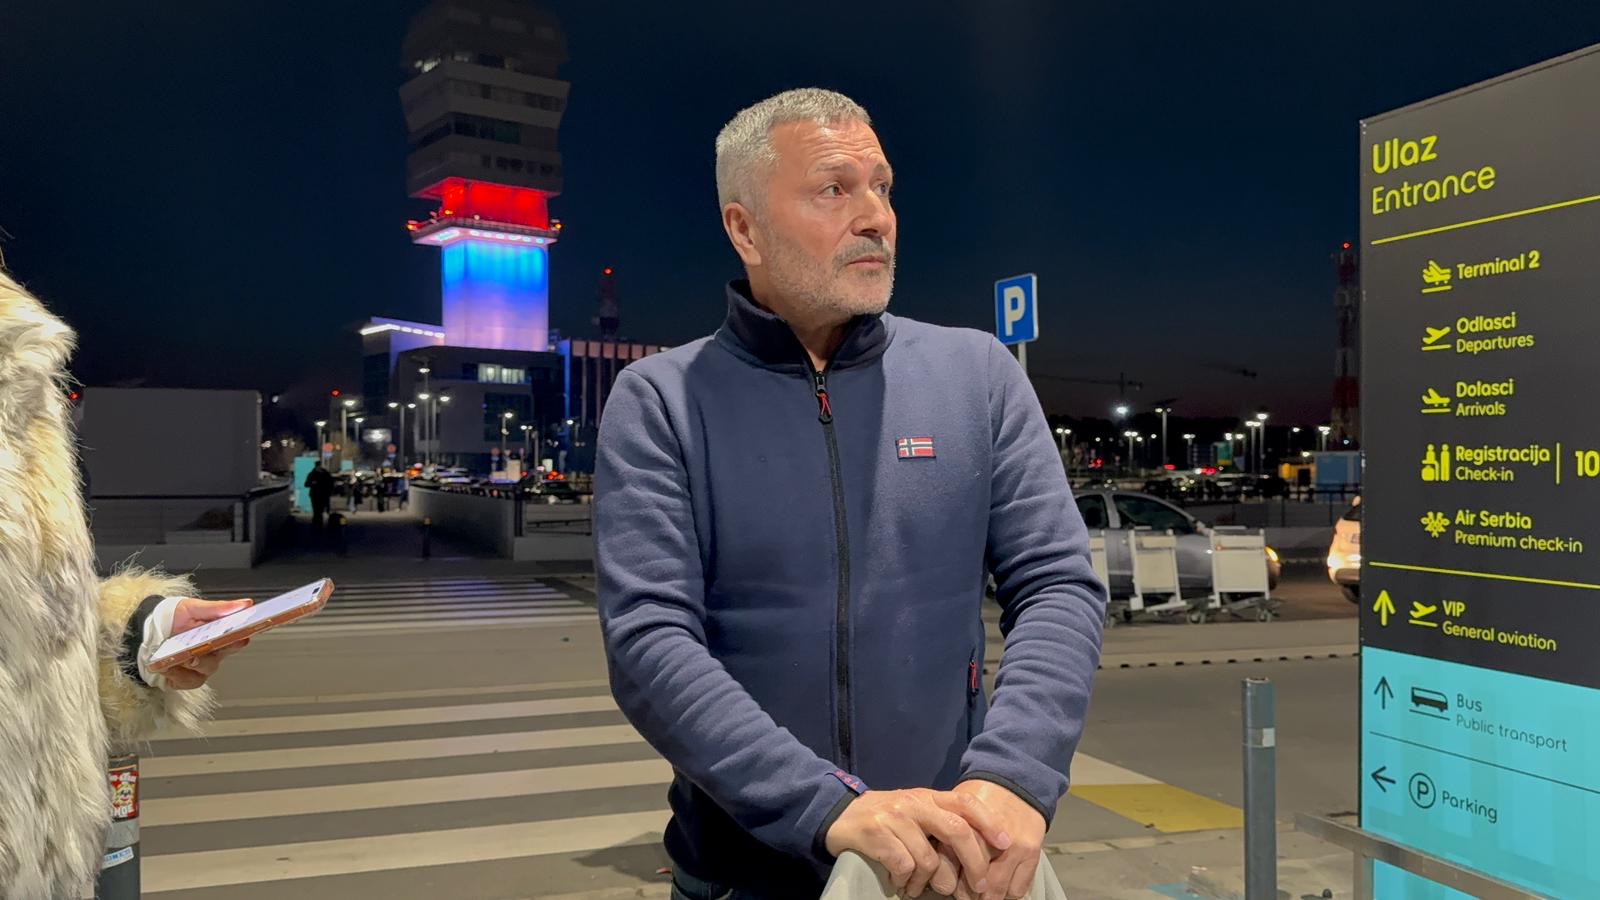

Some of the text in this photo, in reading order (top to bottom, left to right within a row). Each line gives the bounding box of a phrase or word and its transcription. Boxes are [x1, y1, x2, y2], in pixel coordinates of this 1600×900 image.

[1371, 134, 1438, 174] Ulaz
[1372, 165, 1496, 215] Entrance
[1456, 250, 1540, 279] Terminal 2
[1003, 285, 1026, 337] P
[1456, 312, 1516, 334] Odlasci
[1456, 334, 1534, 354] Departures
[1456, 378, 1514, 398] Dolasci
[1455, 402, 1506, 416] Arrivals
[1455, 445, 1600, 477] Registracija 10
[1455, 466, 1514, 482] Check-in
[1455, 510, 1532, 530] Air Serbia
[1455, 530, 1583, 554] Premium check-in
[1442, 599, 1466, 618] VIP
[1442, 620, 1557, 652] General aviation
[1457, 693, 1482, 712] Bus
[1456, 714, 1567, 752] Public transport
[1442, 790, 1498, 824] Parking
